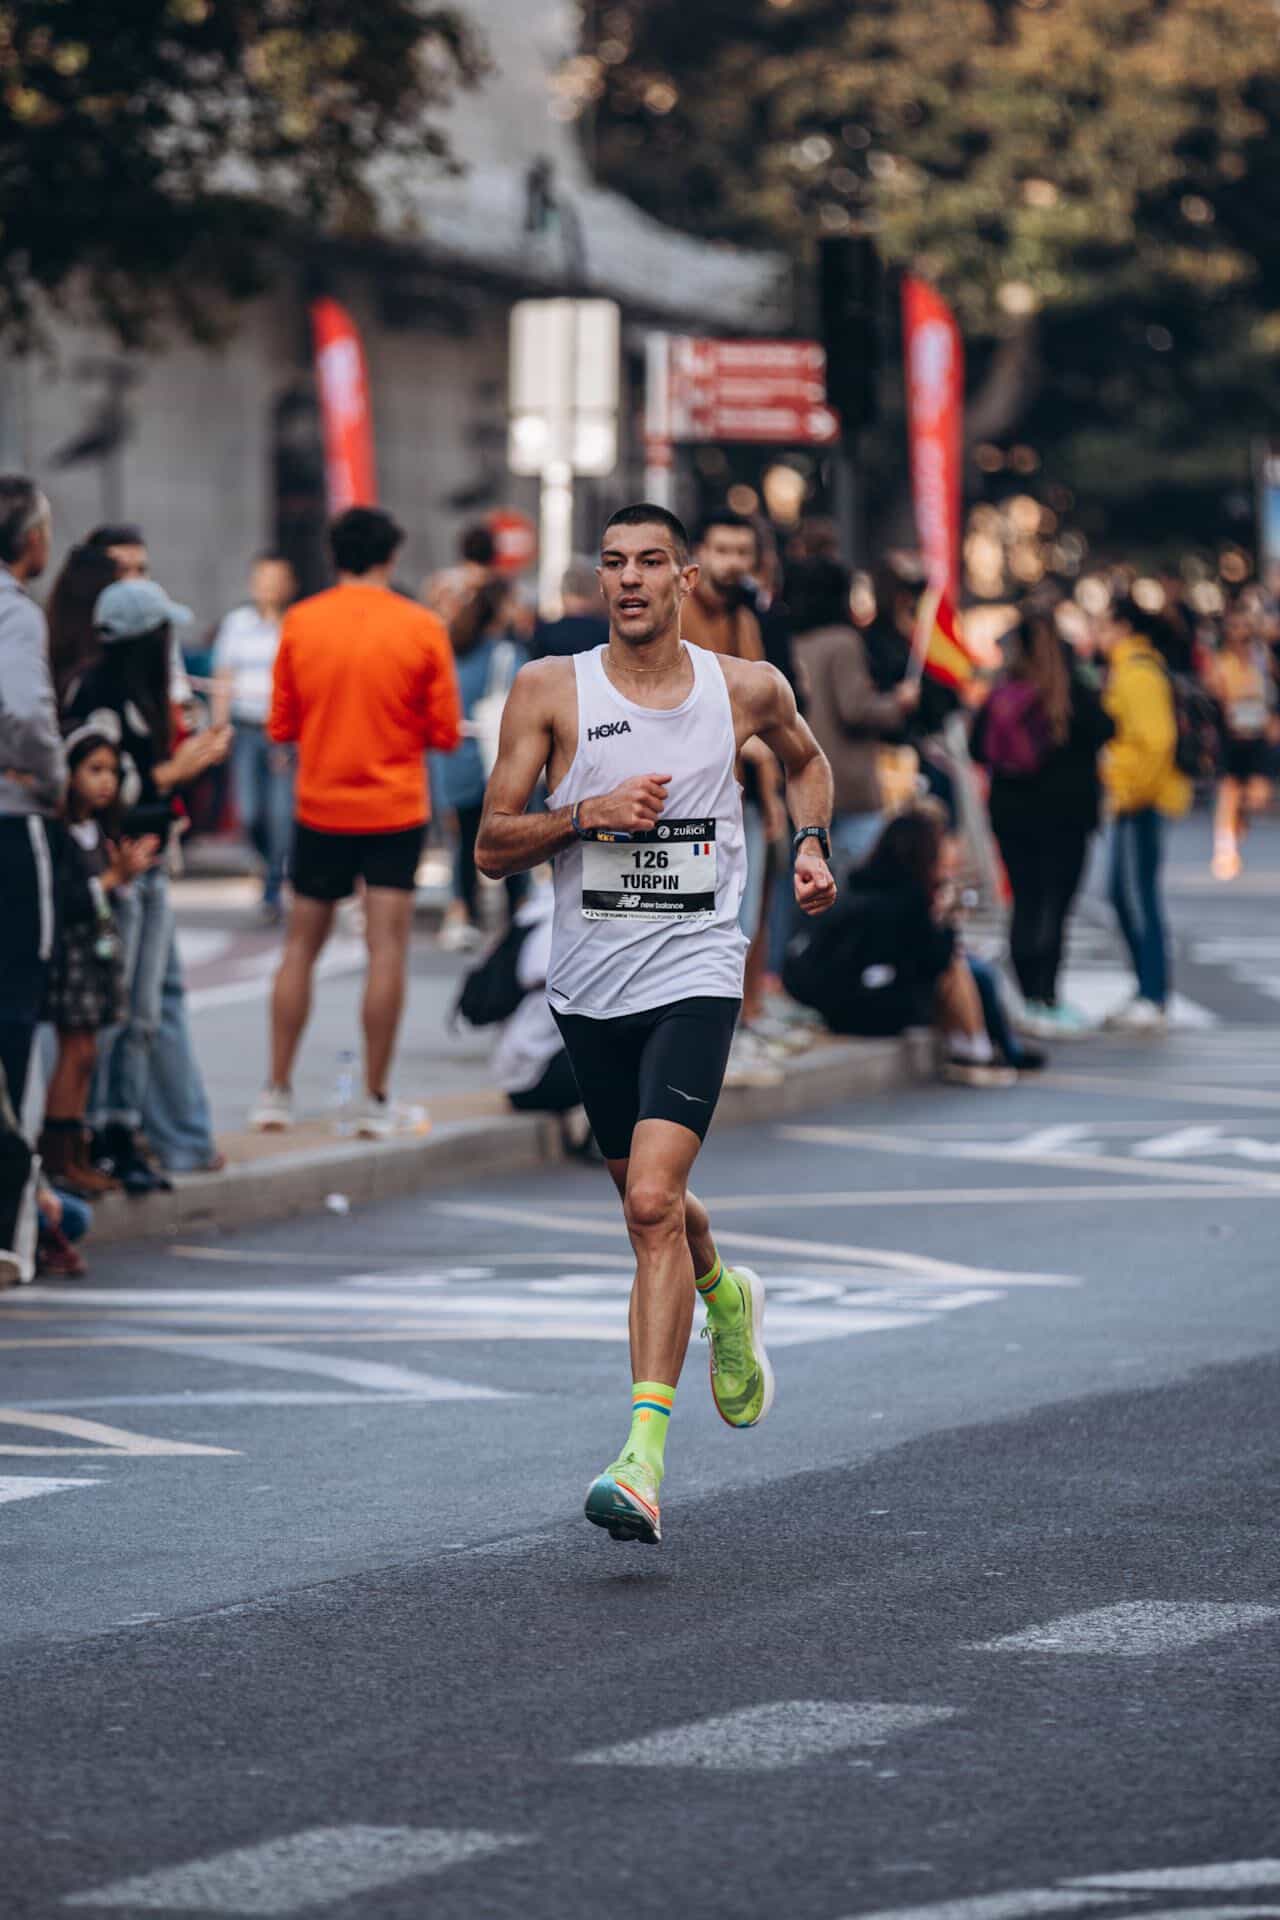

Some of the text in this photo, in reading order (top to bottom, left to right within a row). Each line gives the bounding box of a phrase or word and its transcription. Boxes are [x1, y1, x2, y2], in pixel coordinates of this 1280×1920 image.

[588, 720, 631, 741] HOKA
[632, 850, 669, 868] 126
[621, 874, 679, 889] TURPIN
